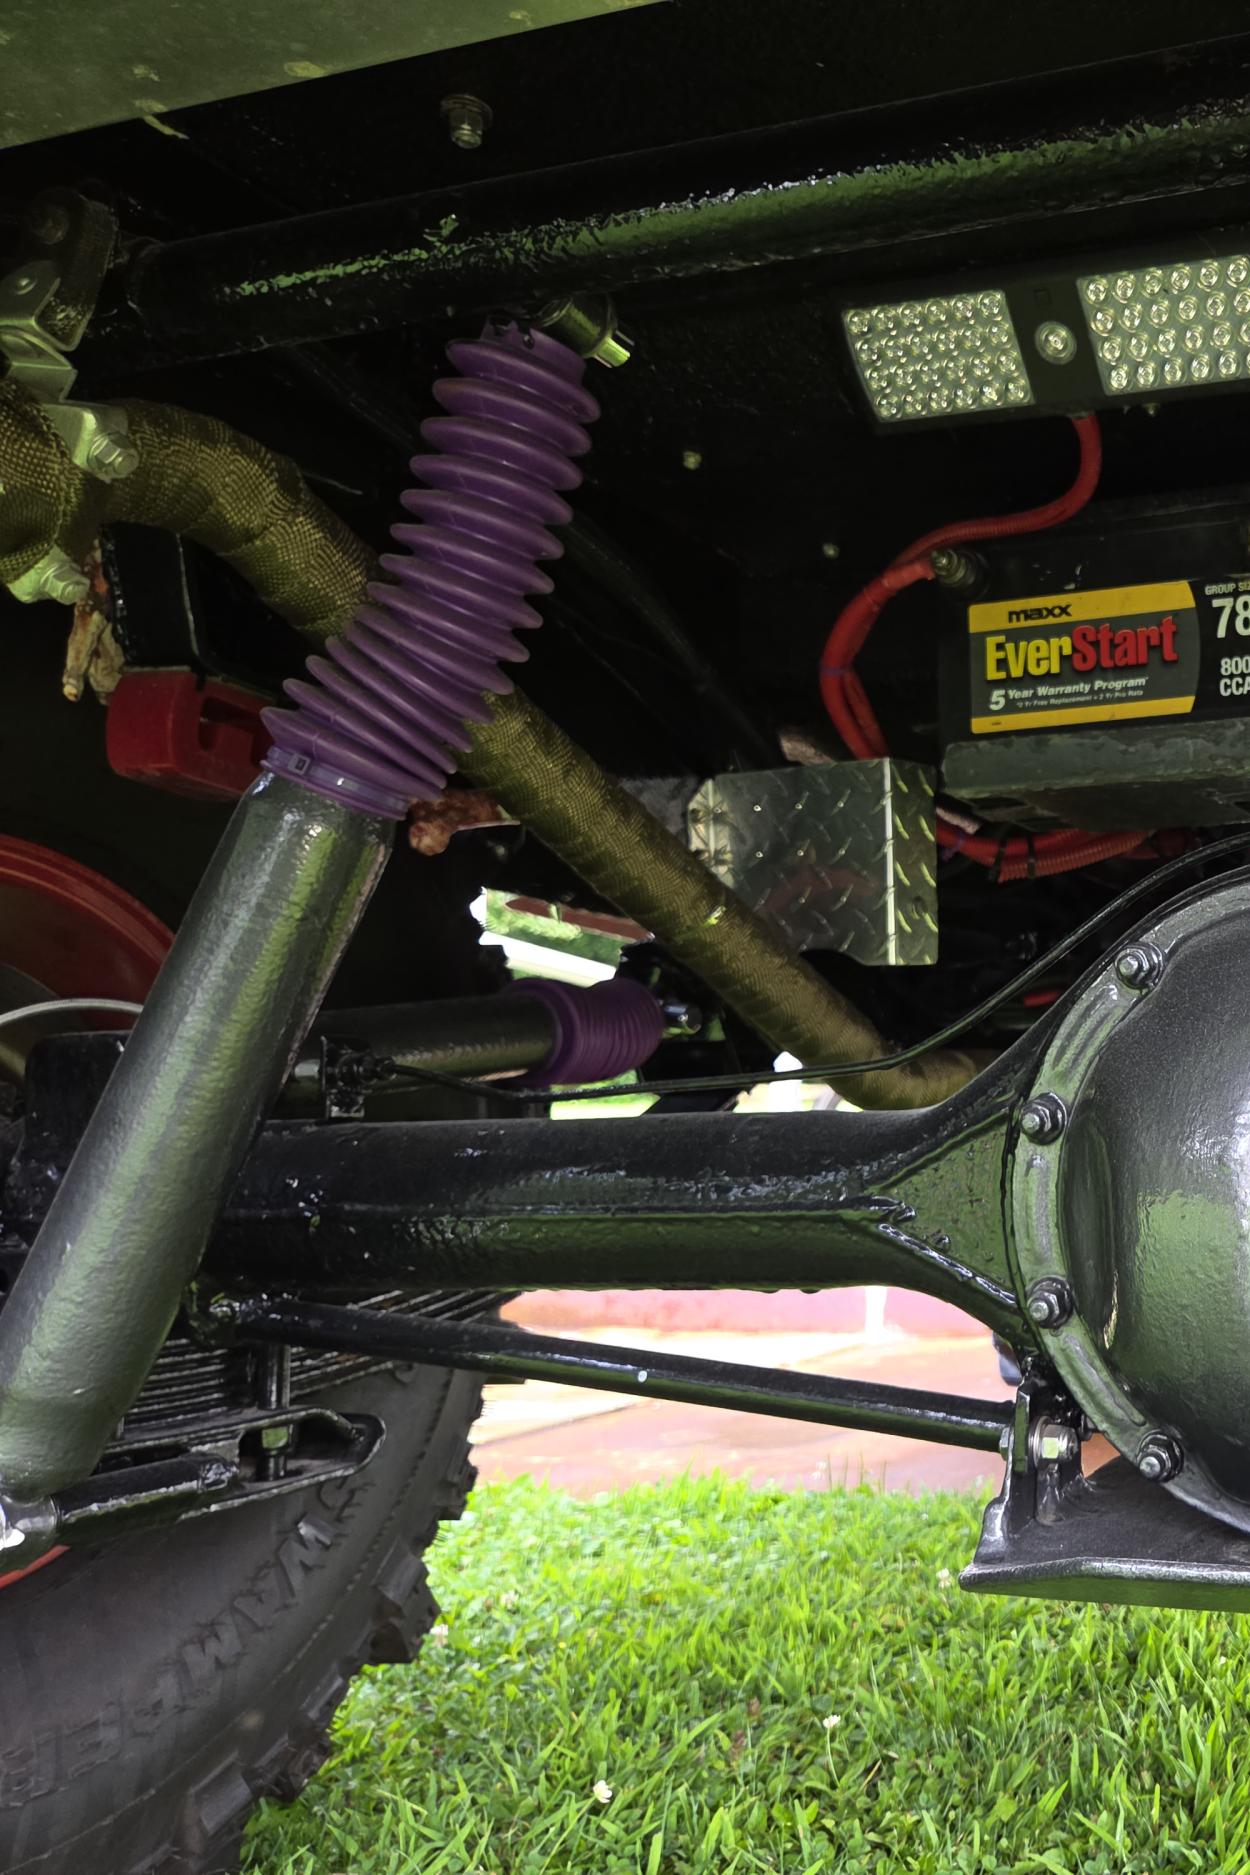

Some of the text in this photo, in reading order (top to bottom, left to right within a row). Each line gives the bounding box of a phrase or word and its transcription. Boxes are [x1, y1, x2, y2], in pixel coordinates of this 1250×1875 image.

[1204, 583, 1236, 595] GROUP
[1008, 604, 1072, 624] maxx
[985, 615, 1179, 680] EverStart
[989, 689, 1006, 711] 5
[1007, 689, 1035, 700] Year
[1037, 682, 1091, 697] Warranty
